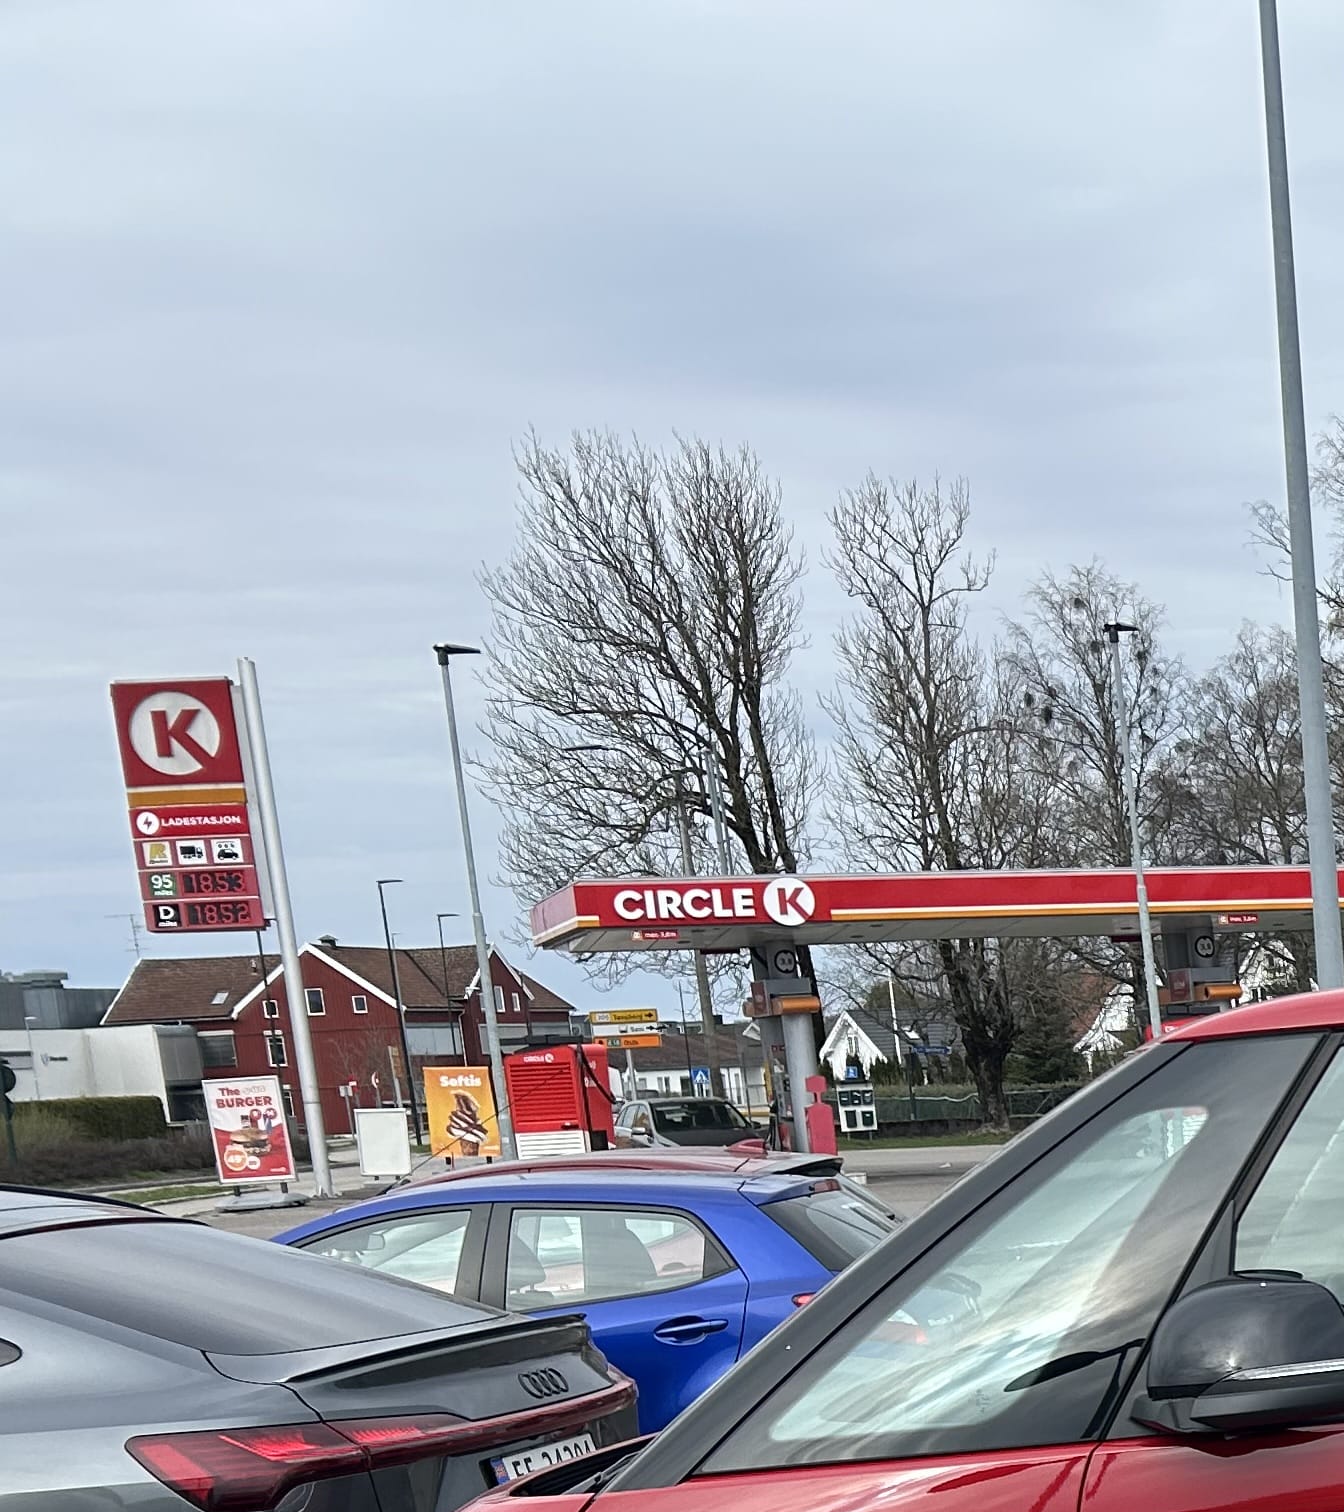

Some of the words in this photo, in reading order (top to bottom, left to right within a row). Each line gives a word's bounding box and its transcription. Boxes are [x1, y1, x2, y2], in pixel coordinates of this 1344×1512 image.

[161, 815, 242, 827] LADESTASJON
[151, 874, 173, 889] 95
[613, 888, 756, 921] CIRCLE
[775, 886, 813, 923] K
[159, 905, 175, 921] D
[218, 1087, 240, 1096] The
[216, 1096, 273, 1109] BURGER
